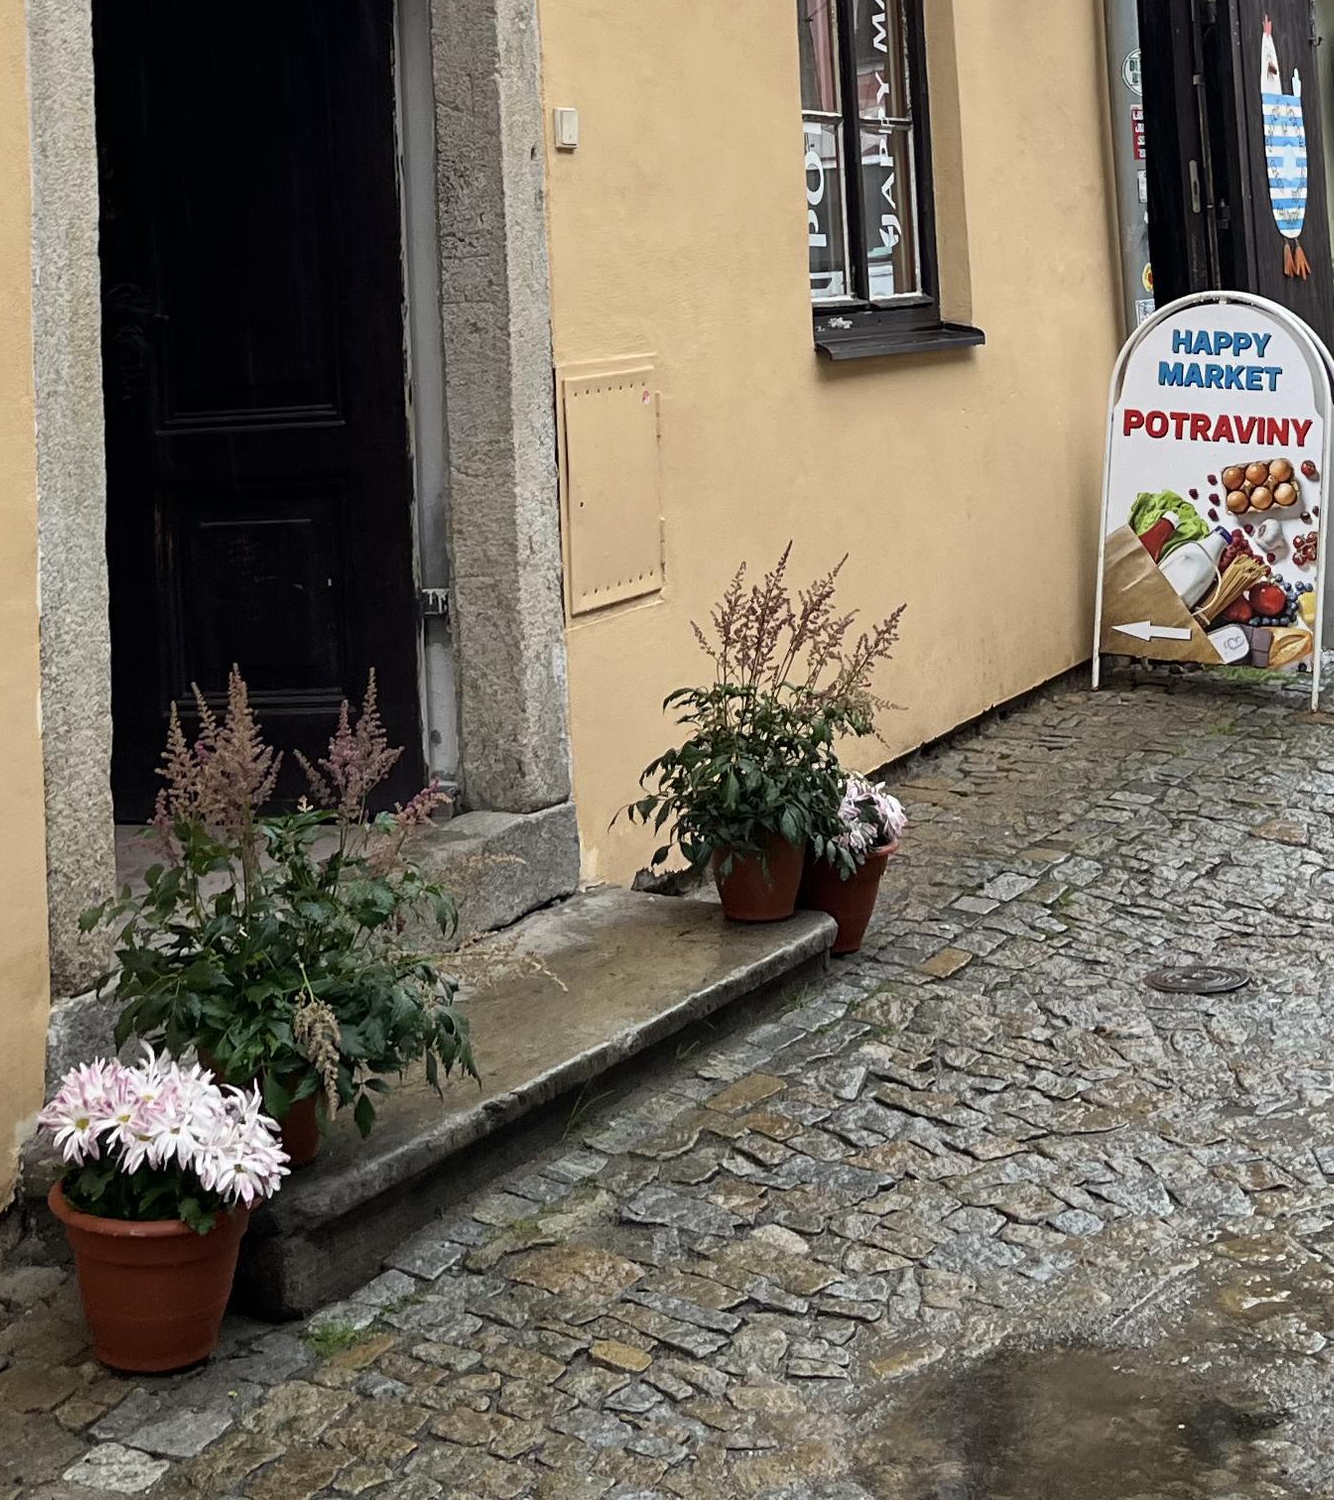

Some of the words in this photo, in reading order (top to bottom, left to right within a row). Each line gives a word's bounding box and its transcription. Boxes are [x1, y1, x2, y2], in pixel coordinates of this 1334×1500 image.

[1172, 329, 1271, 358] HAPPY
[1158, 362, 1282, 392] MARKET
[1124, 410, 1312, 447] POTRAVINY
